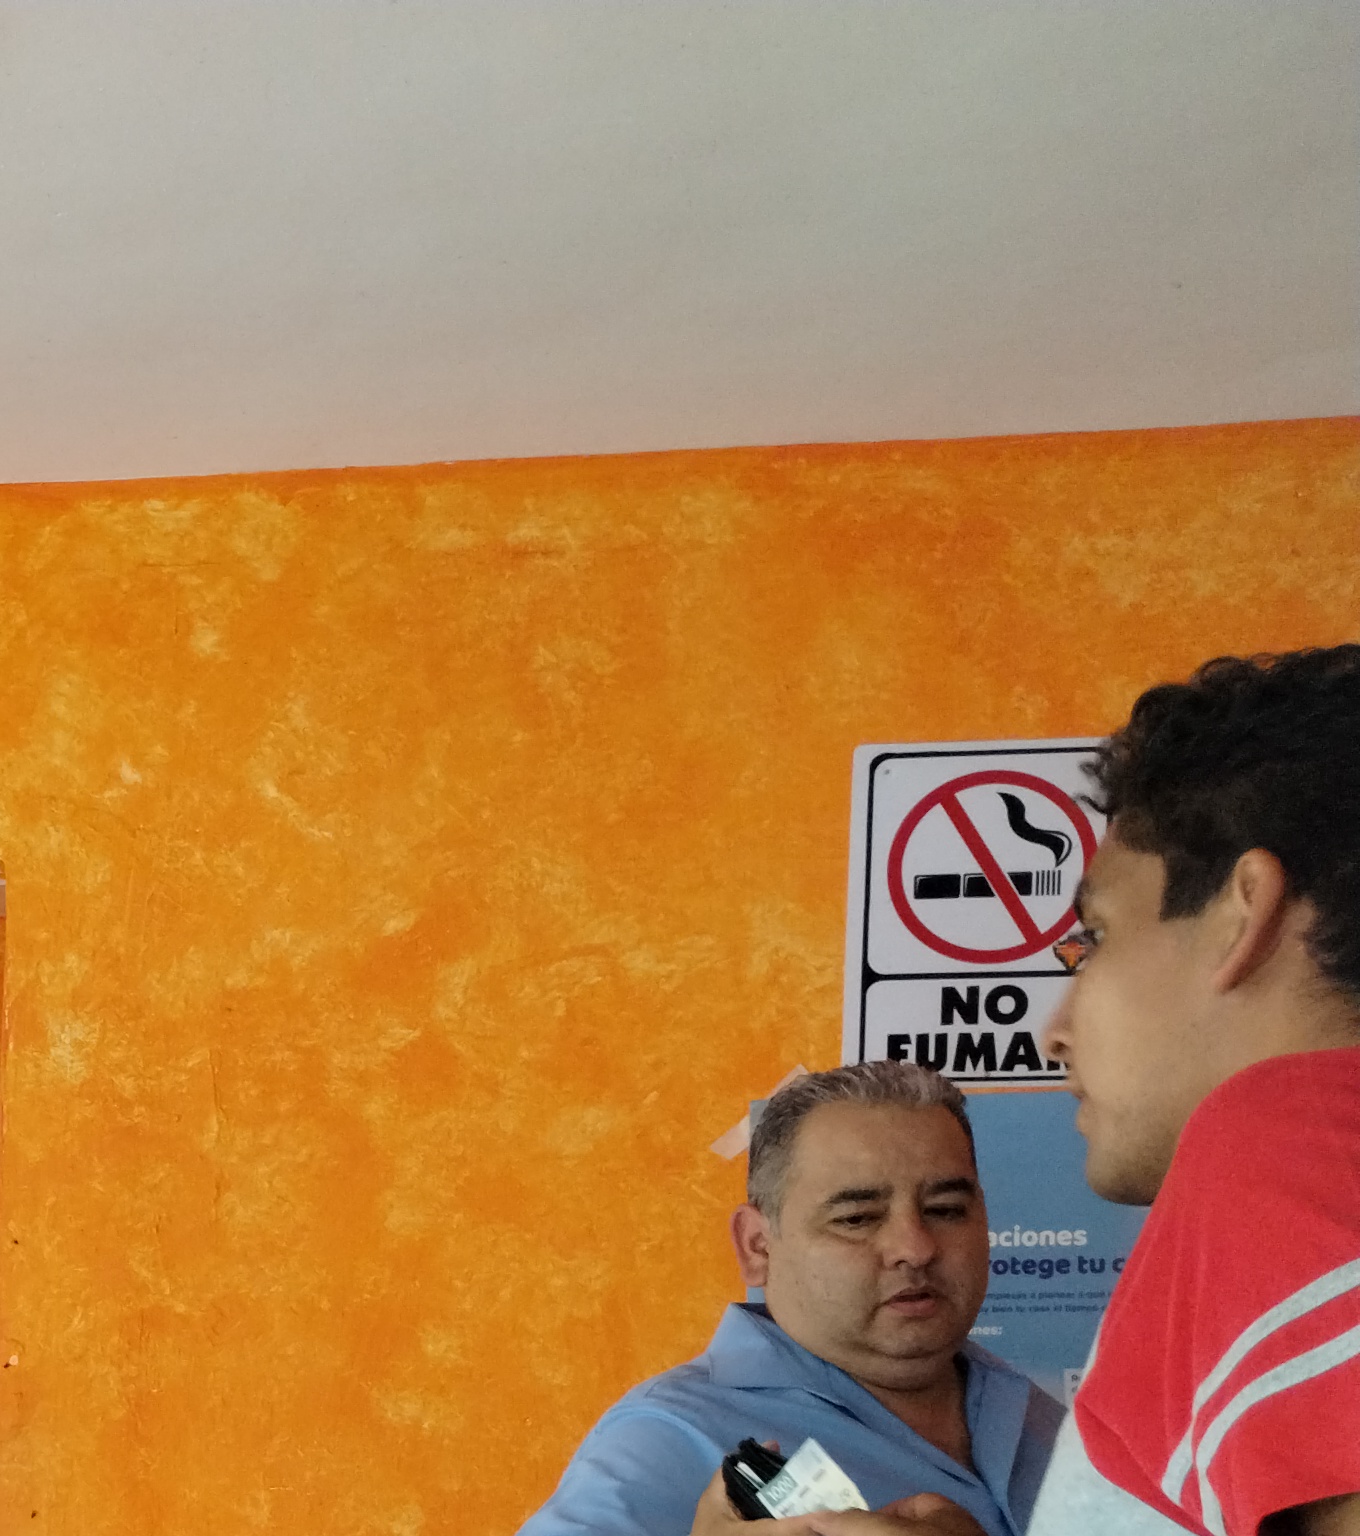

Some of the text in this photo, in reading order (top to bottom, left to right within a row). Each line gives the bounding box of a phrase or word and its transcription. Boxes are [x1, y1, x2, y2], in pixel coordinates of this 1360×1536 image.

[940, 984, 1029, 1025] NO
[887, 1032, 1070, 1072] FUMA
[989, 1256, 1071, 1280] otege
[1077, 1255, 1106, 1275] tu
